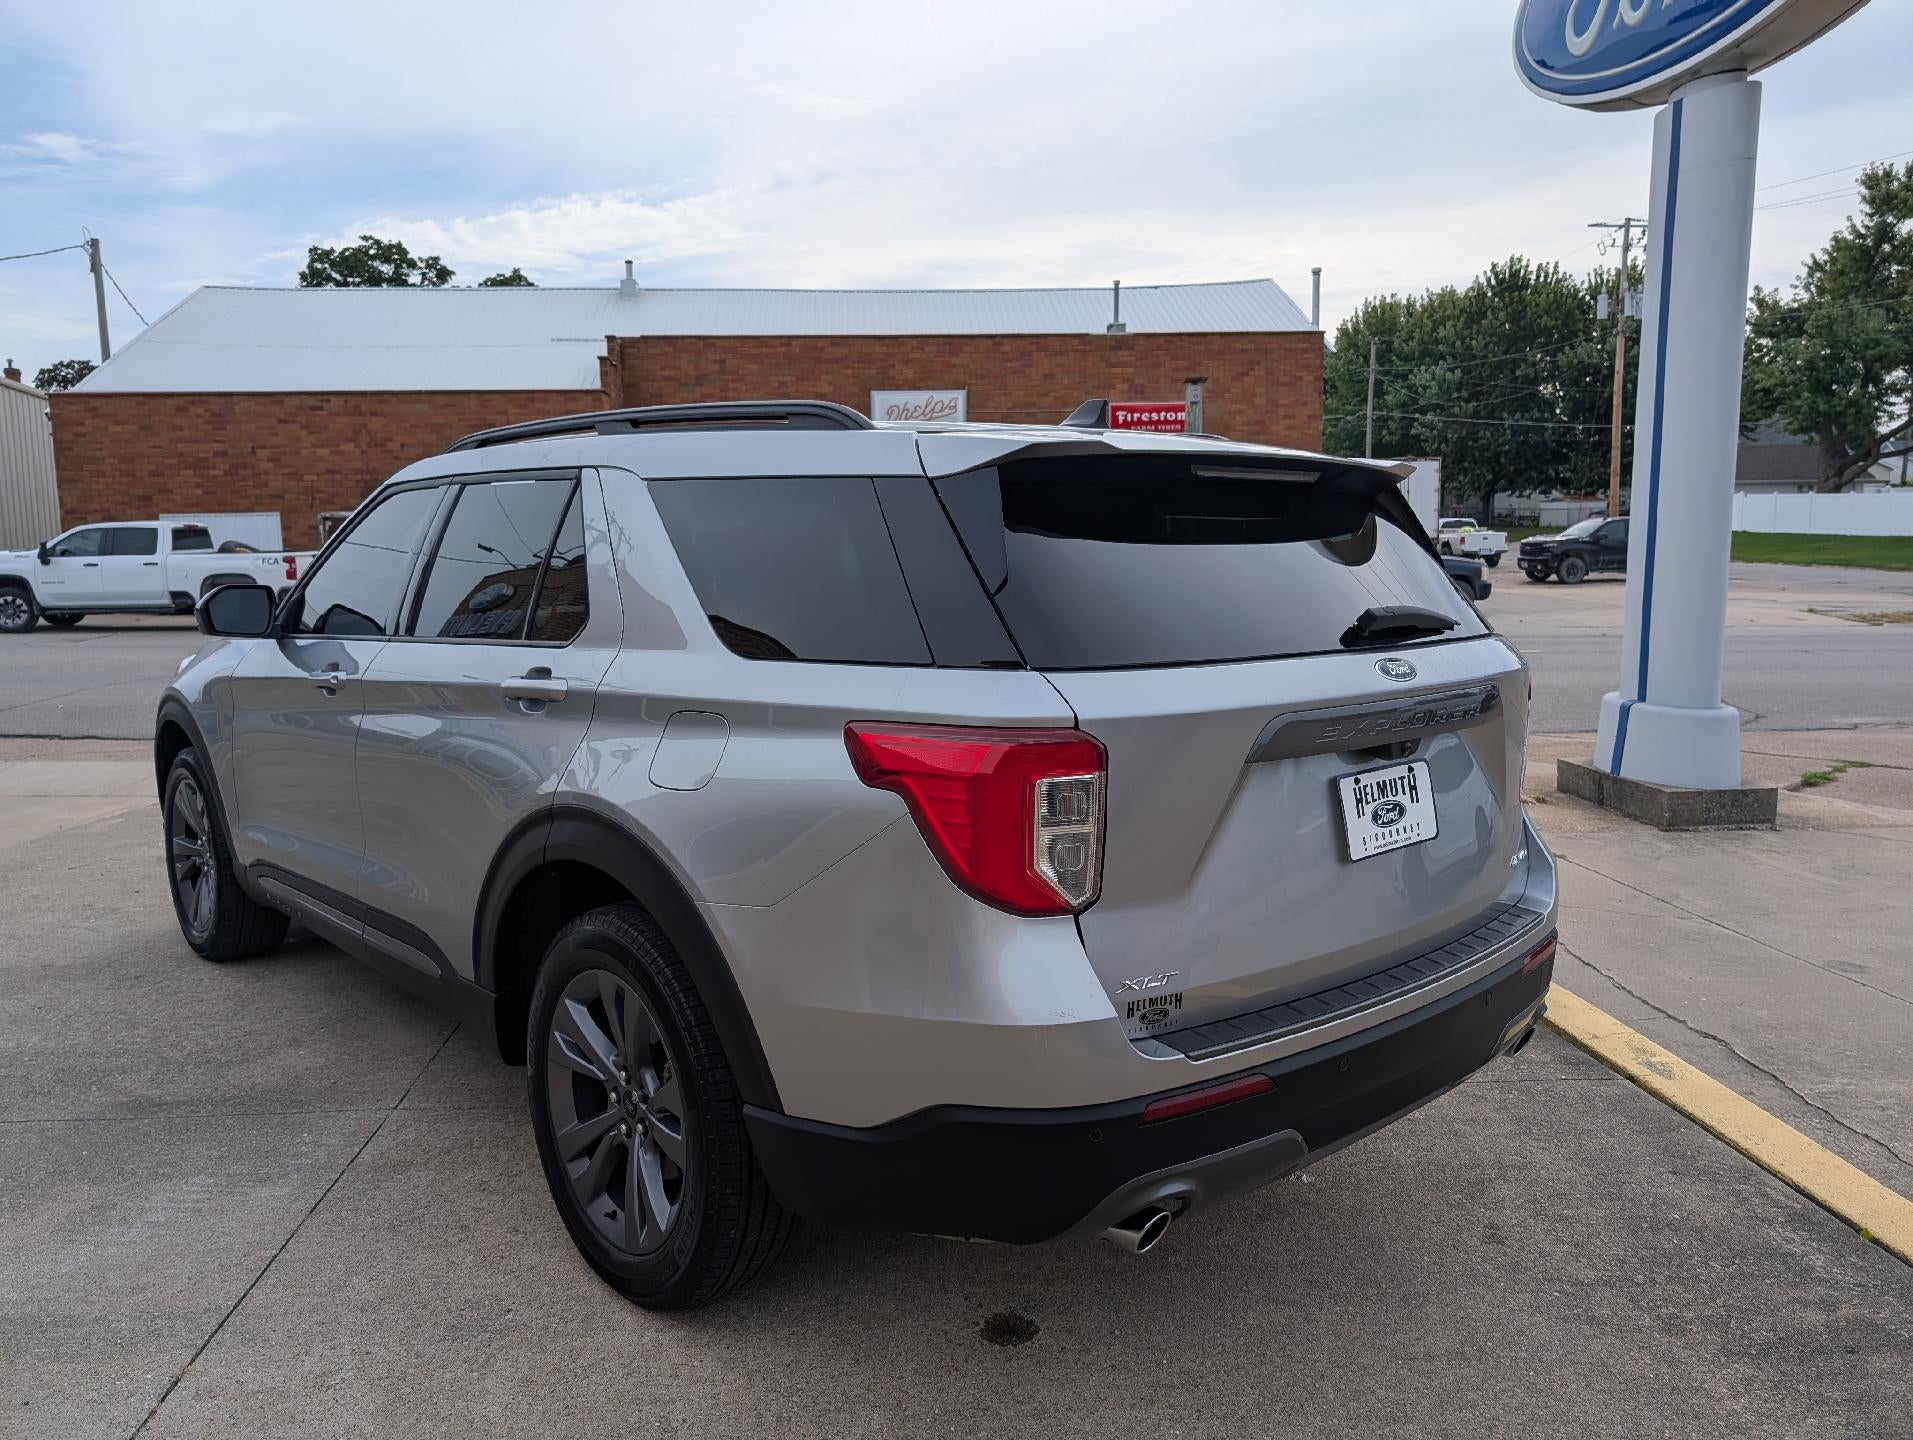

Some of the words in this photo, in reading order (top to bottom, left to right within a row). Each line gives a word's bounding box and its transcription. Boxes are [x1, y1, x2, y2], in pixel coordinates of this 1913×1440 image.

[1116, 411, 1186, 424] Fireston
[261, 557, 280, 566] FCA
[1315, 702, 1482, 743] EXPLORER
[1353, 773, 1420, 819] HELMUTH
[1377, 804, 1400, 825] Ford
[1114, 971, 1179, 994] XLT
[1126, 991, 1183, 1020] HELMUTH
